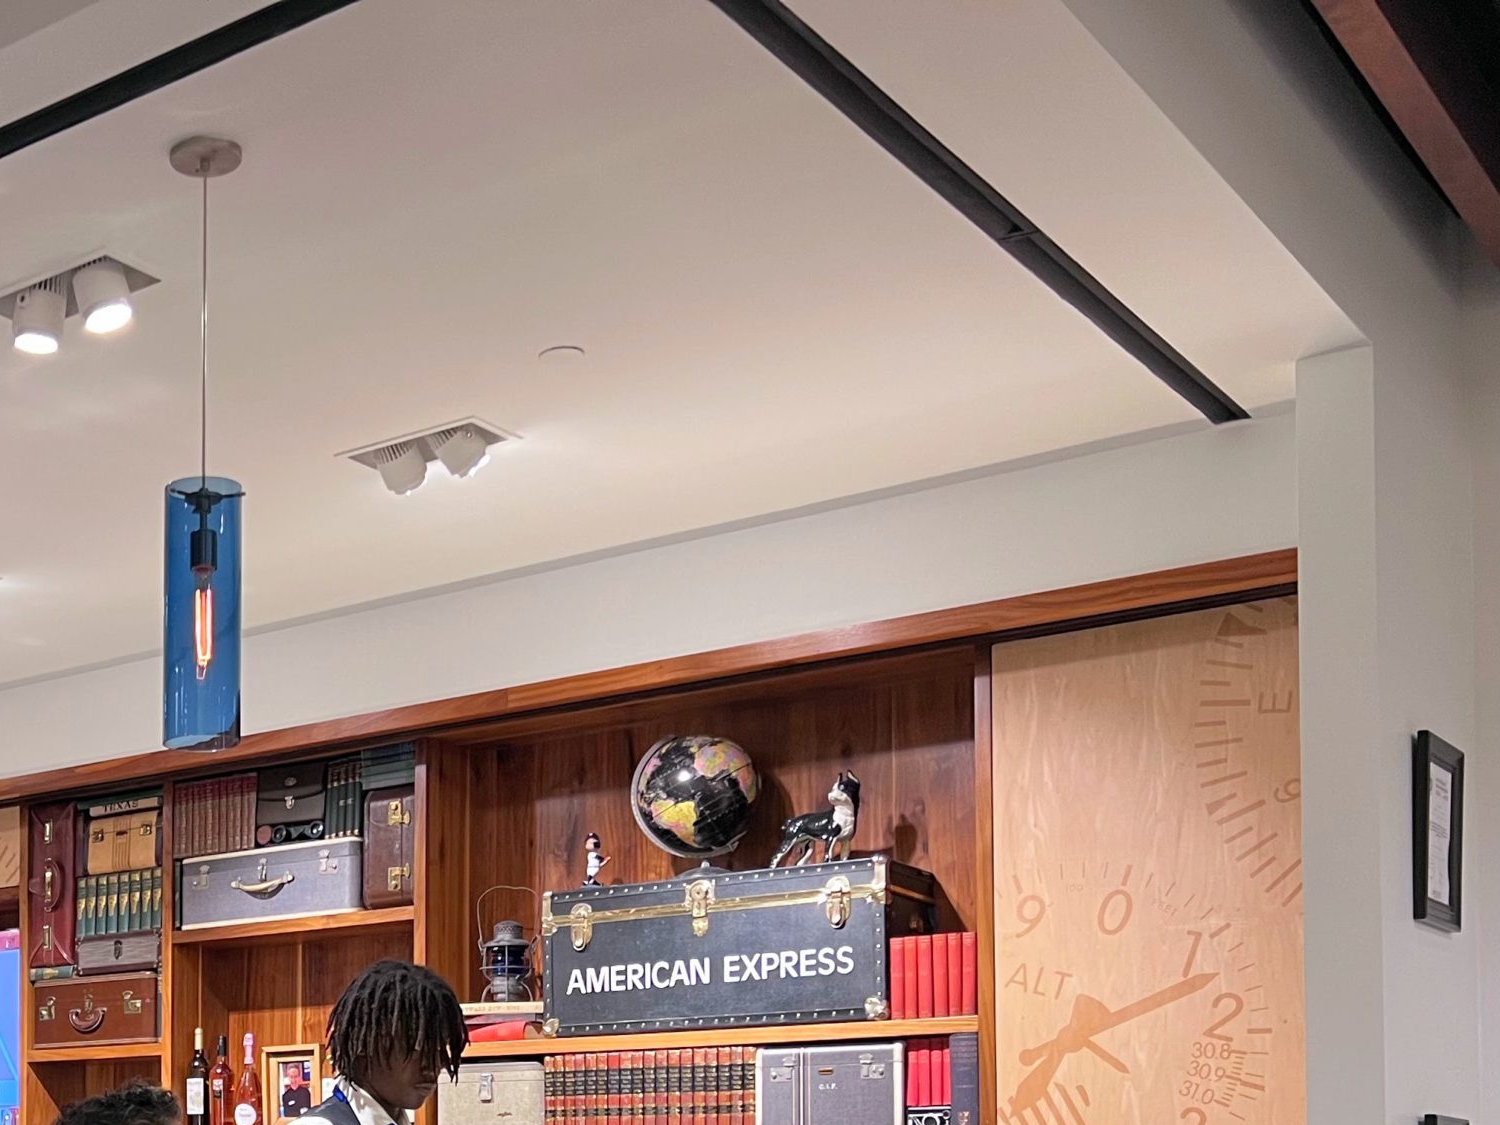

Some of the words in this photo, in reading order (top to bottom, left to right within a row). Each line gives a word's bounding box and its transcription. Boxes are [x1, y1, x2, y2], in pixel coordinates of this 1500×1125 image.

[102, 800, 139, 813] TEXAS
[1015, 894, 1047, 938] 9
[565, 957, 711, 996] AMERICAN
[723, 946, 855, 984] EXPRESS
[1182, 930, 1202, 979] 1
[1004, 963, 1073, 1000] ALT
[1202, 992, 1244, 1043] 2
[1191, 1041, 1231, 1060] 30.8
[1187, 1060, 1226, 1083] 30.9
[1179, 1080, 1215, 1105] 31.0
